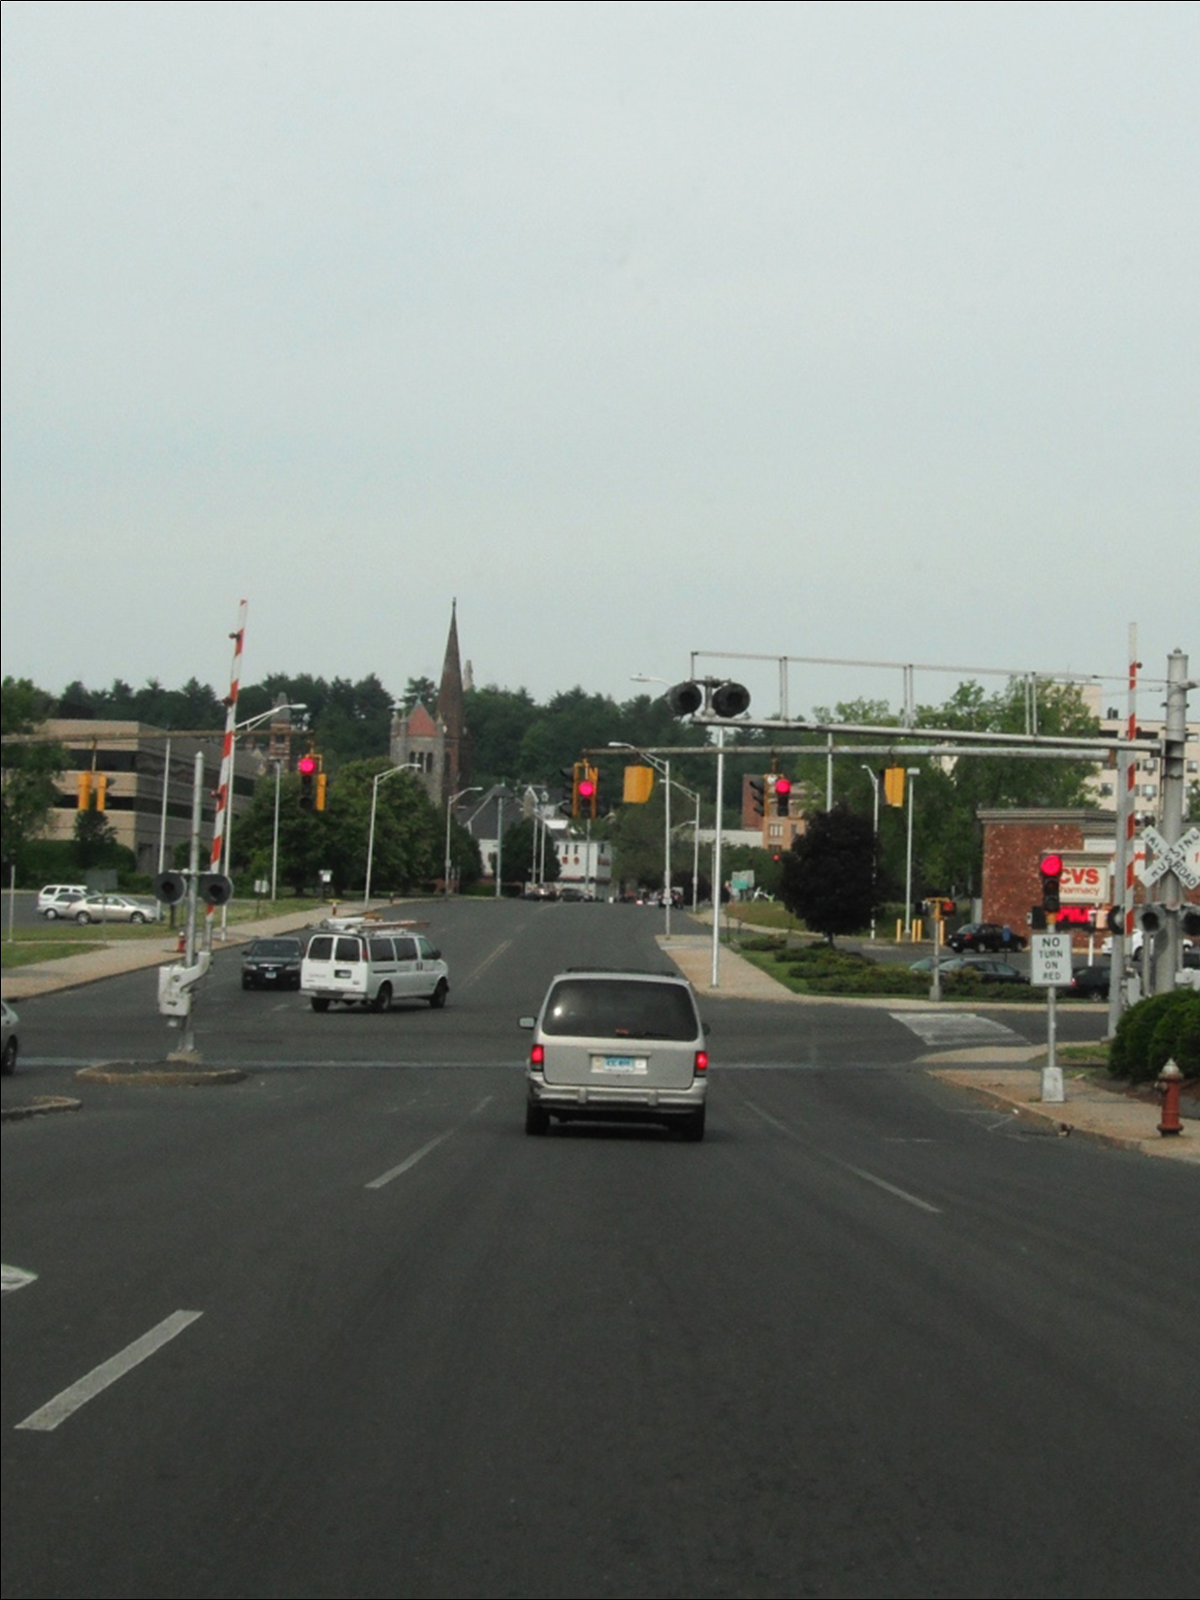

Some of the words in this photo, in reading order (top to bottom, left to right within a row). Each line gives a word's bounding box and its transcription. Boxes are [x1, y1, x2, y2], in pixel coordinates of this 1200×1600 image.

[1059, 868, 1099, 885] CVS
[1172, 860, 1198, 887] ROAD
[1059, 886, 1099, 896] harmacy
[1042, 937, 1060, 947] NO
[1039, 950, 1063, 958] TURN
[1045, 961, 1058, 969] ON
[1043, 971, 1061, 980] RED
